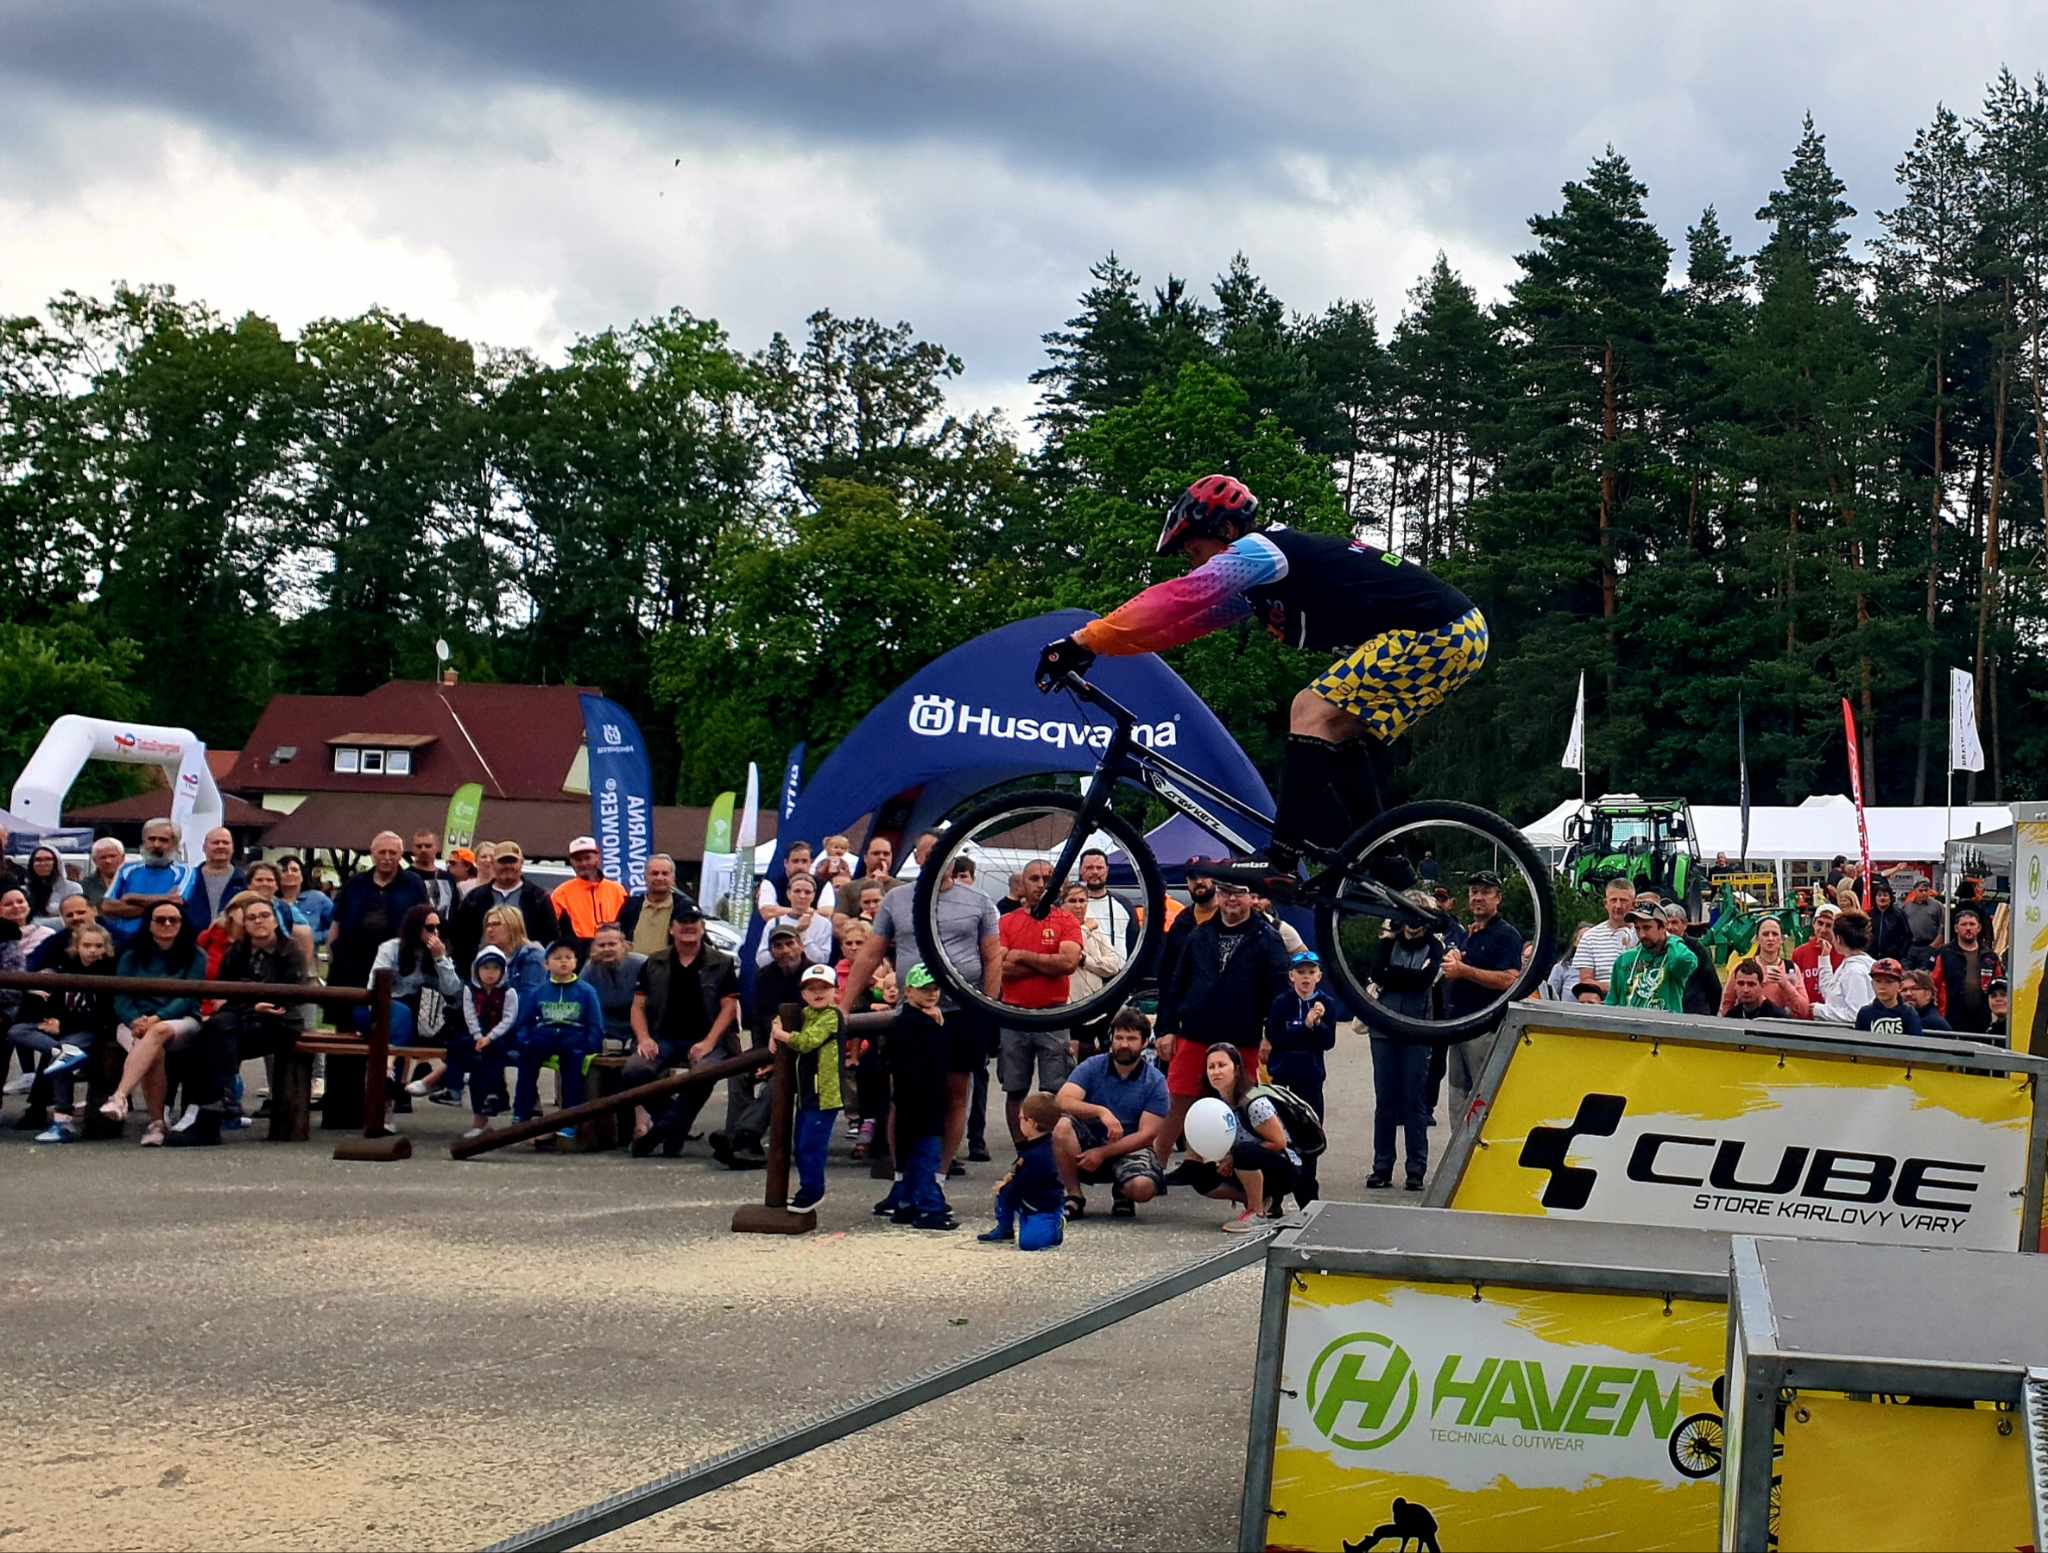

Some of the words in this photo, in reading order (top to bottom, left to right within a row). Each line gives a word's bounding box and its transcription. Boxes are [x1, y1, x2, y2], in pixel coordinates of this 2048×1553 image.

[958, 704, 1177, 749] Husqvana
[1871, 1017, 1904, 1034] VANS
[1627, 1133, 1986, 1213] CUBE
[1693, 1194, 1774, 1216] STORE
[1777, 1202, 1894, 1226] KARLOVY
[1900, 1213, 1966, 1233] VARY
[1431, 1354, 1681, 1440] HAVEN
[1430, 1428, 1507, 1446] TECHNICAL
[1512, 1434, 1585, 1451] OUTWEAR
